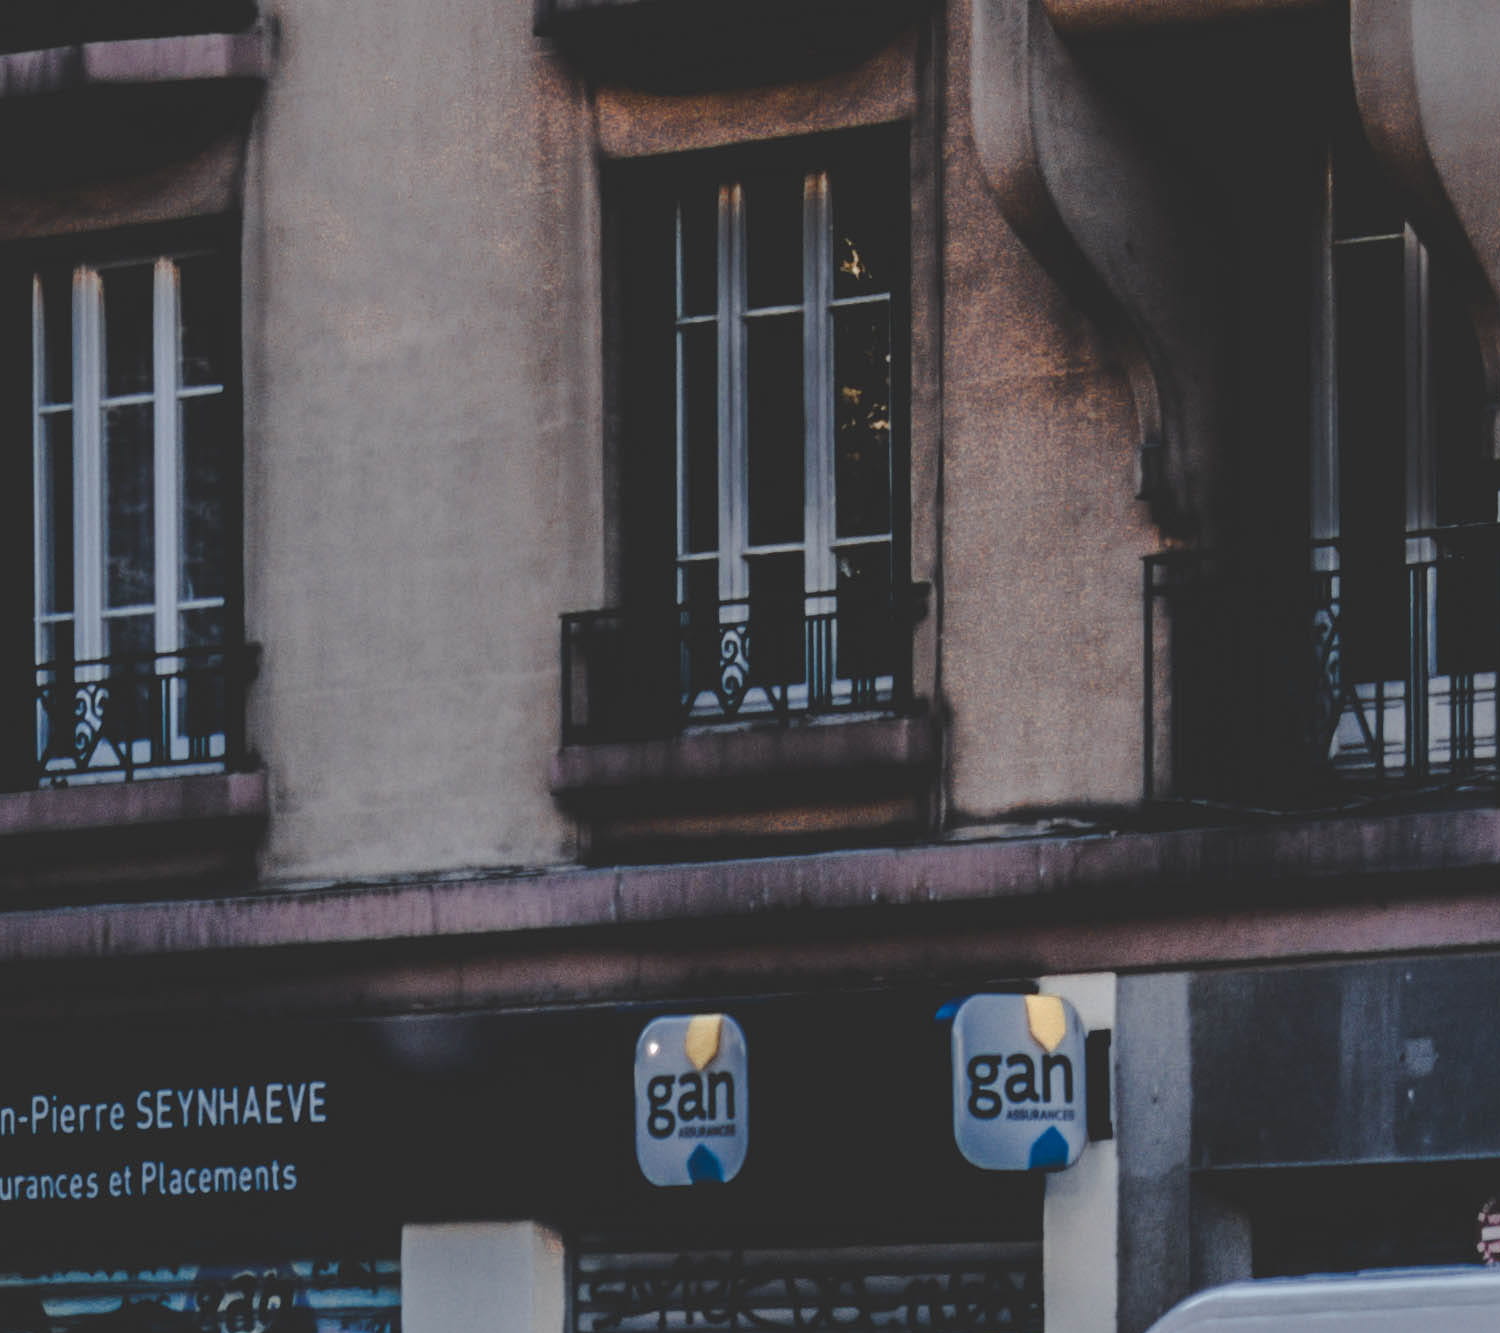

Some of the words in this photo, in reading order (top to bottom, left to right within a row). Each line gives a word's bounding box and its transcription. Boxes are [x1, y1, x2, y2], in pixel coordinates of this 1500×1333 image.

[136, 1081, 326, 1131] SEYNHAEVE
[648, 1071, 736, 1139] gan
[967, 1053, 1073, 1119] gan
[1006, 1108, 1074, 1121] ASSURANCES
[108, 1166, 132, 1196] et
[141, 1160, 297, 1196] Placements
